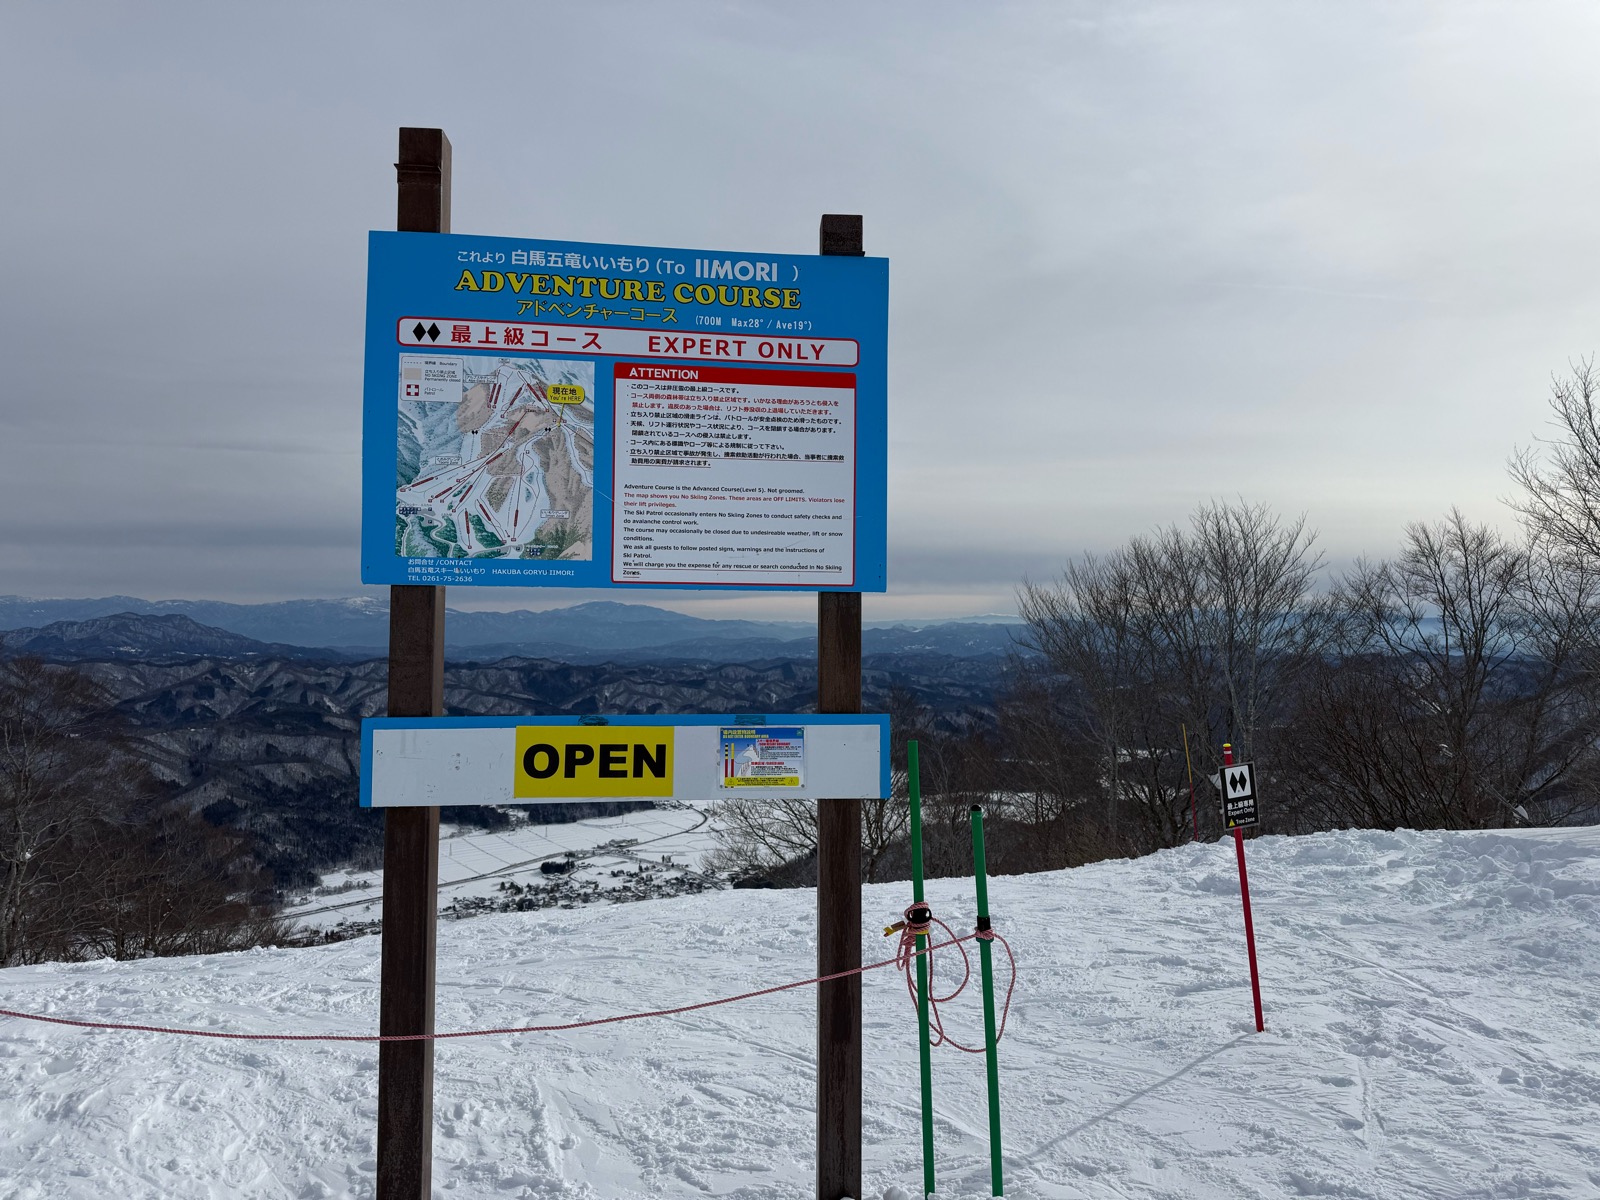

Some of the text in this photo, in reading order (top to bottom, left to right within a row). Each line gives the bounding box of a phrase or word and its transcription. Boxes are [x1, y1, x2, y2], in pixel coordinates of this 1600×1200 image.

[457, 251, 505, 263] これより
[511, 250, 649, 272] 白馬五竜いいもり
[695, 259, 778, 281] IIMORI
[455, 270, 801, 309] ADVENTURE COURSE
[517, 300, 678, 323] アドベンチャーコース
[451, 325, 825, 360] 最上級コース EXPERT ONLY
[628, 367, 701, 379] ATTENTION
[553, 387, 577, 395] 現在地
[523, 744, 667, 778] OPEN
